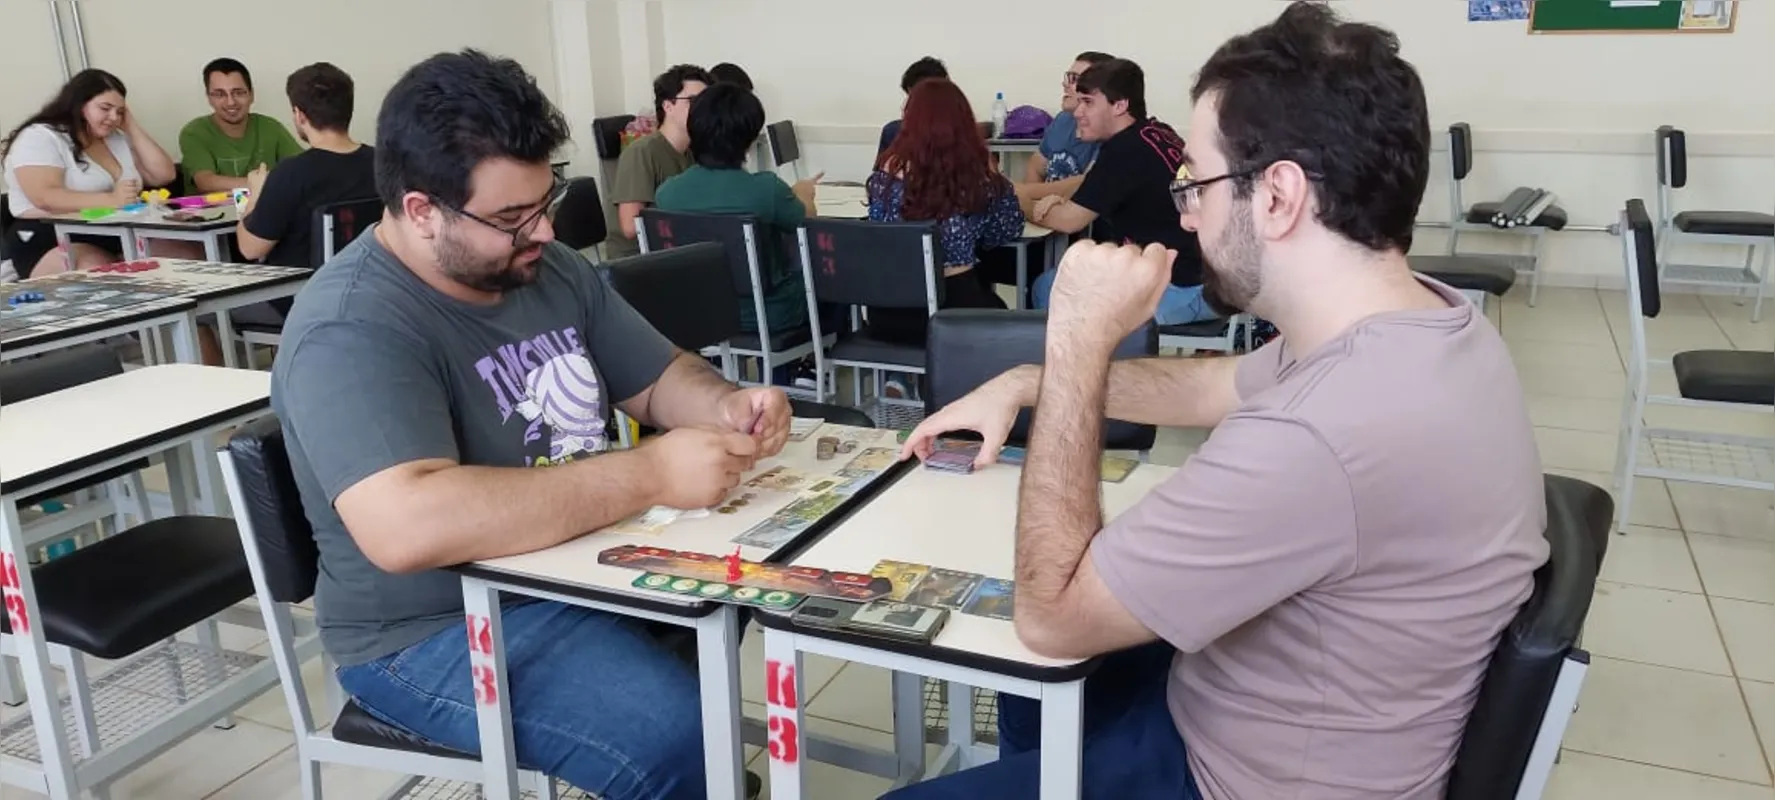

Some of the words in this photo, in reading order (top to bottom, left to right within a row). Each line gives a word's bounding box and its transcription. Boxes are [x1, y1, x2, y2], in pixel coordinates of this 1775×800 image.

[466, 614, 492, 655] K
[473, 665, 498, 705] 3
[766, 660, 797, 709] K
[768, 716, 798, 763] 3
